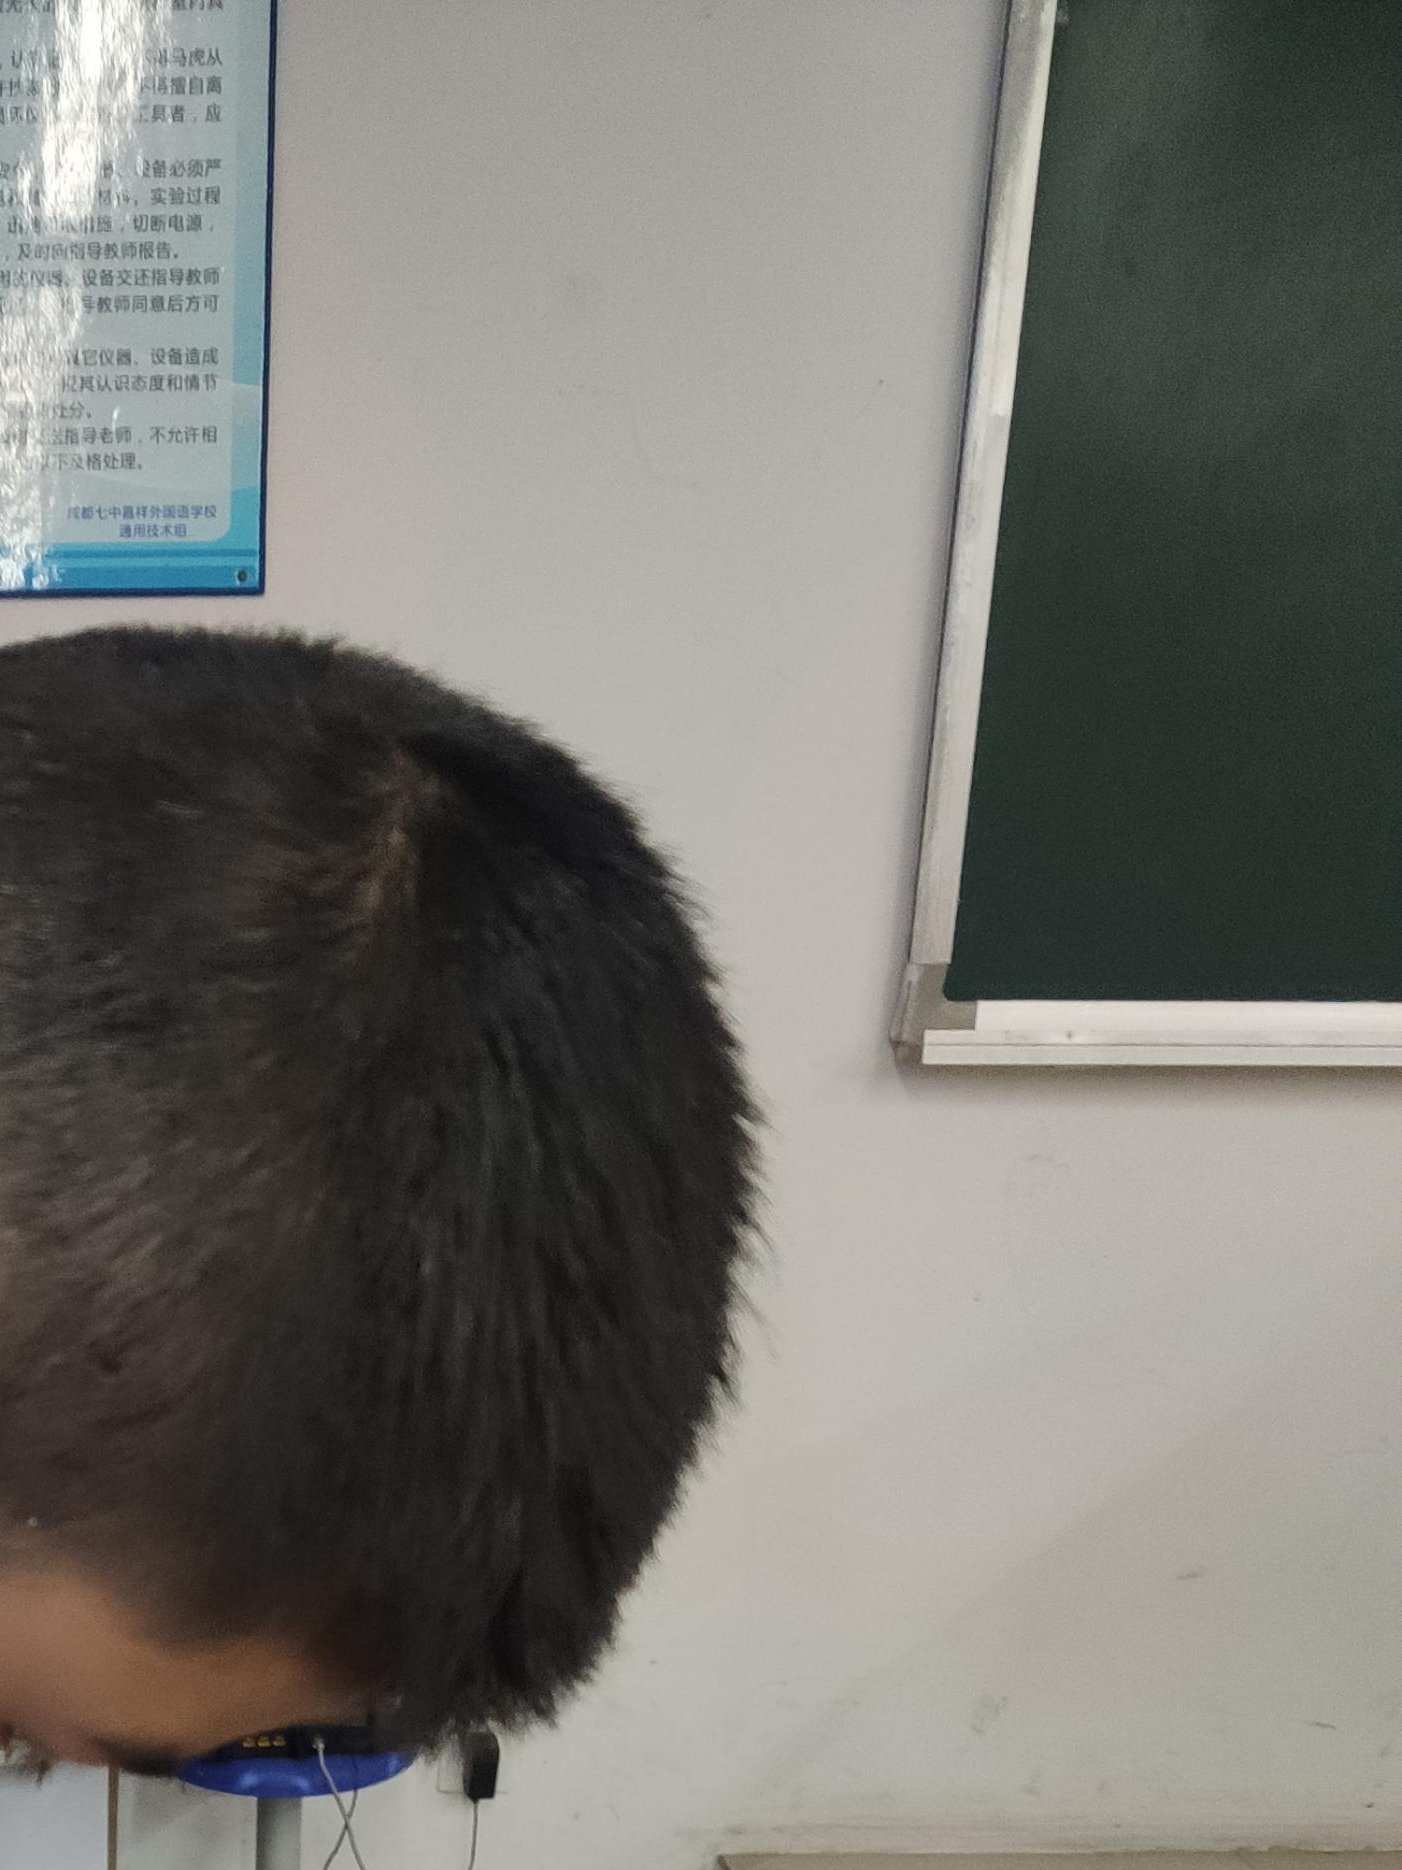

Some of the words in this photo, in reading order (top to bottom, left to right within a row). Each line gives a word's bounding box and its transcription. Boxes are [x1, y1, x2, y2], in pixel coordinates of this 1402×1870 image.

[67, 504, 218, 520] 成都七中嘉祥外国语学校
[119, 523, 188, 538] 通用技术组
